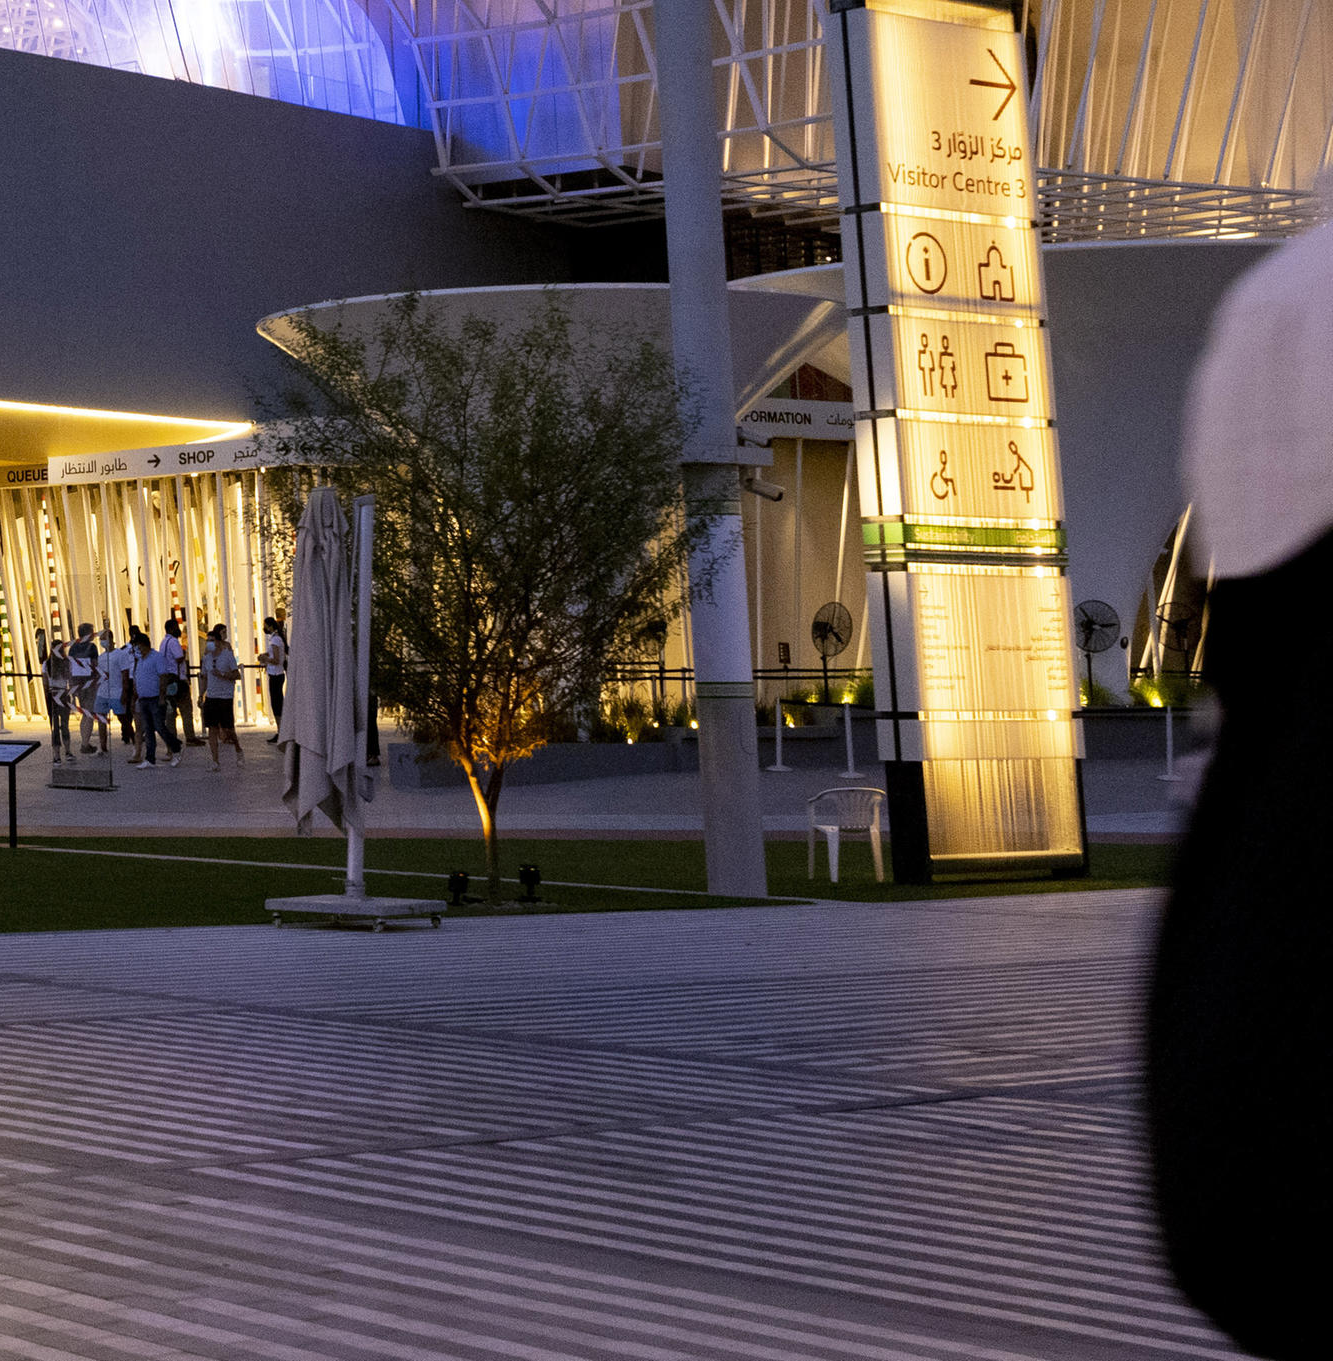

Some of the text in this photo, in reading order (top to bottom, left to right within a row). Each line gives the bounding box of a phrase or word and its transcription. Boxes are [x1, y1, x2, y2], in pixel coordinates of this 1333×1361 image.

[931, 130, 942, 151] 3
[989, 137, 1023, 166] مركز
[887, 162, 1026, 199] Visitor Centre 3
[740, 410, 812, 425] FORMATION
[60, 457, 128, 479] طابور الانتظار
[178, 450, 215, 466] SHOP
[6, 468, 48, 484] QUEUE
